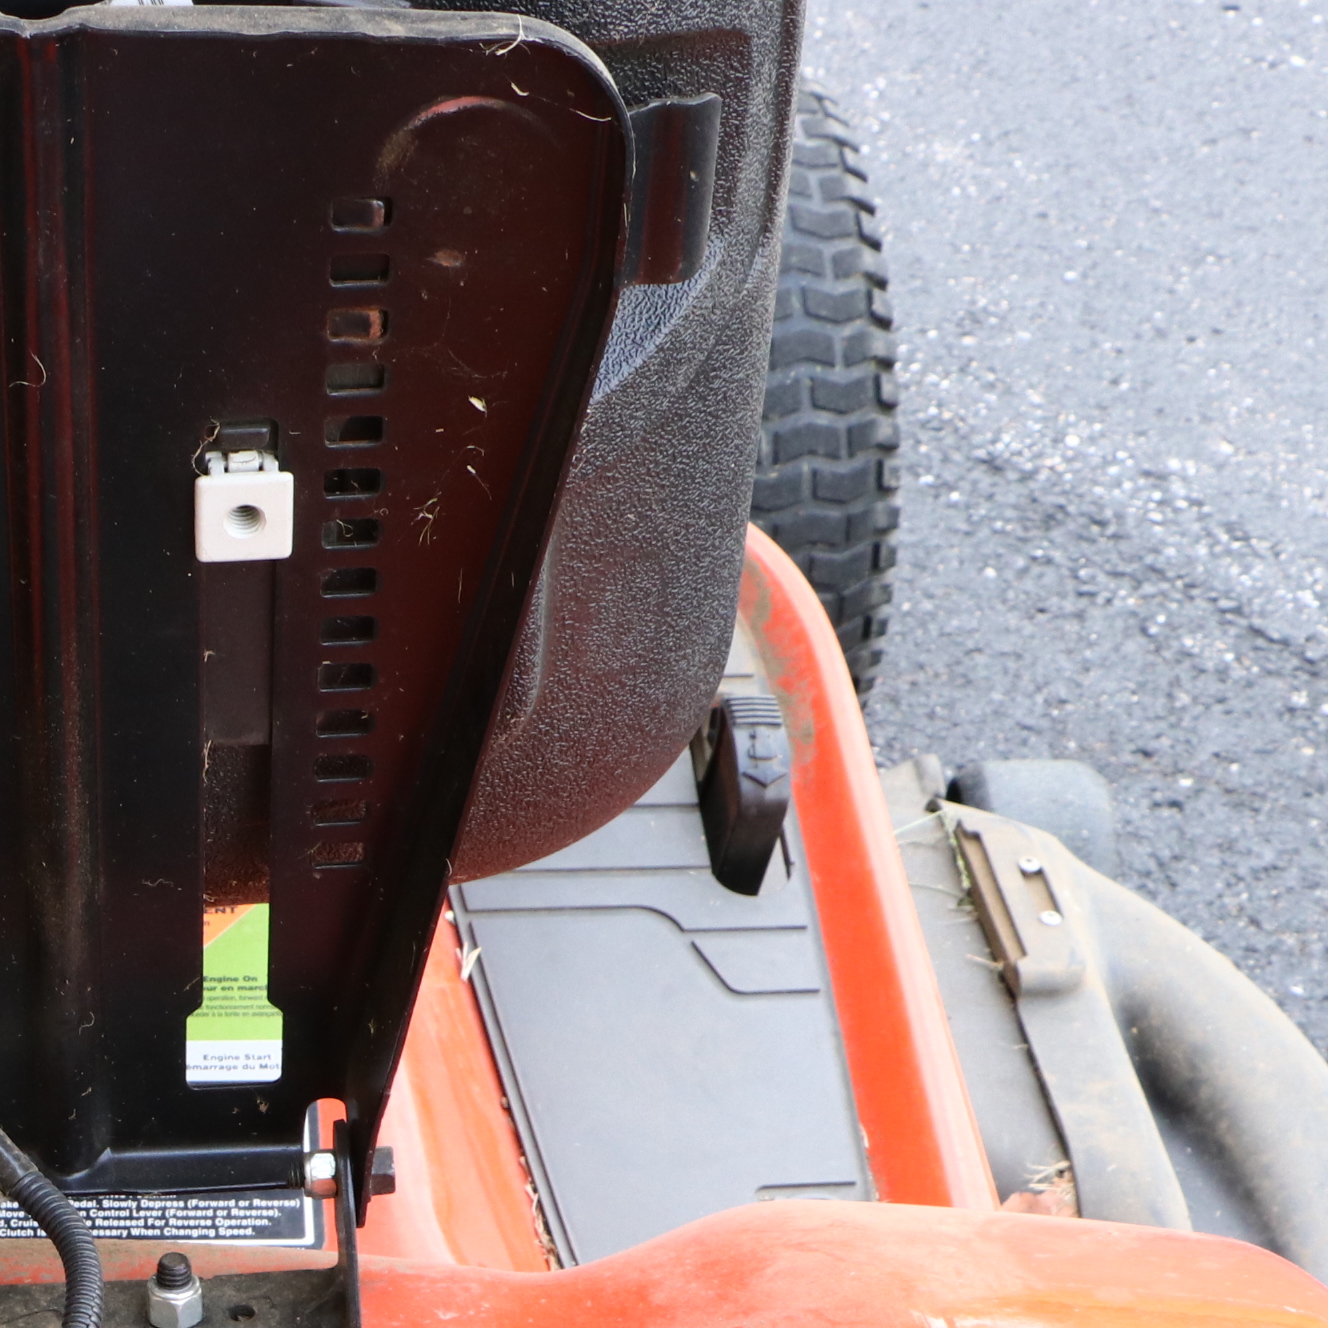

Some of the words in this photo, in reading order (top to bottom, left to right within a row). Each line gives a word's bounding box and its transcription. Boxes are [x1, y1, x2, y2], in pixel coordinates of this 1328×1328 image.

[102, 1199, 138, 1209] Slowly
[140, 1199, 184, 1209] Depress
[187, 1199, 235, 1209] (Forward
[253, 1198, 300, 1208] Reverse)
[89, 1209, 129, 1218] Control
[133, 1208, 162, 1217] Lever
[165, 1208, 214, 1217] (Forward
[230, 1208, 281, 1217] Reverse).
[95, 1218, 145, 1227] Released
[147, 1218, 166, 1226] For
[168, 1218, 212, 1226] Reverse
[215, 1218, 272, 1227] Operation.
[130, 1227, 161, 1236] When
[163, 1227, 216, 1237] Changing
[218, 1227, 255, 1237] Speed.
